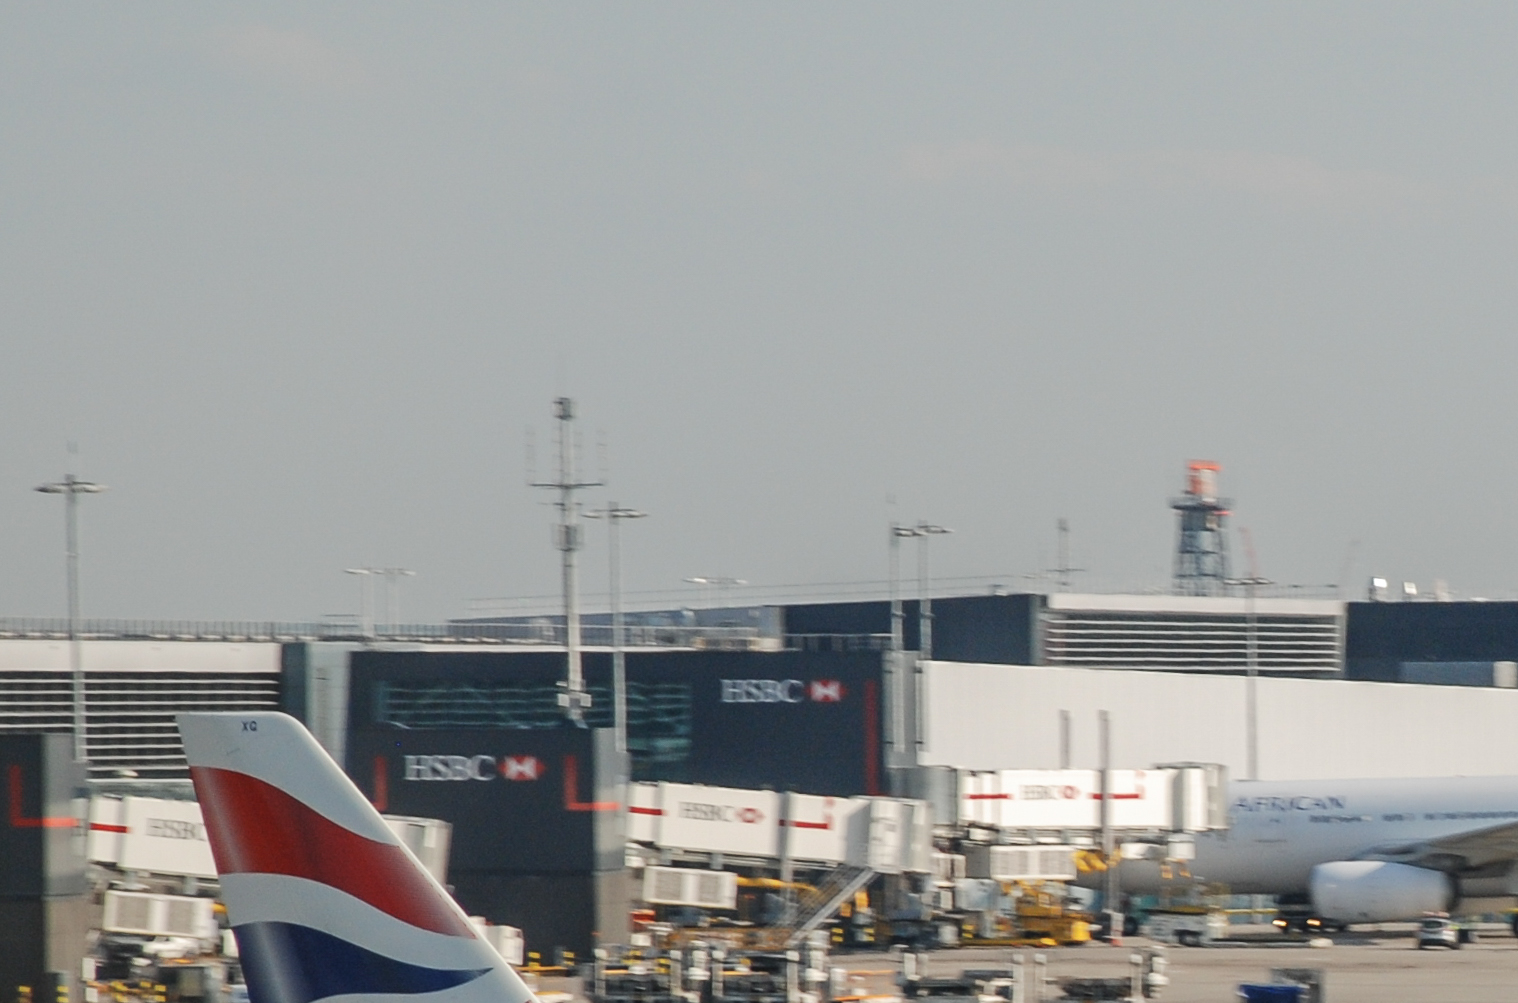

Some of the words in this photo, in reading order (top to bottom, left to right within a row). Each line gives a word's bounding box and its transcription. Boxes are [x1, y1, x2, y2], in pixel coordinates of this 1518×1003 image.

[721, 679, 804, 702] HSBC
[241, 720, 257, 731] XG
[404, 754, 496, 781] HSBC
[1231, 796, 1345, 812] AFRICAN
